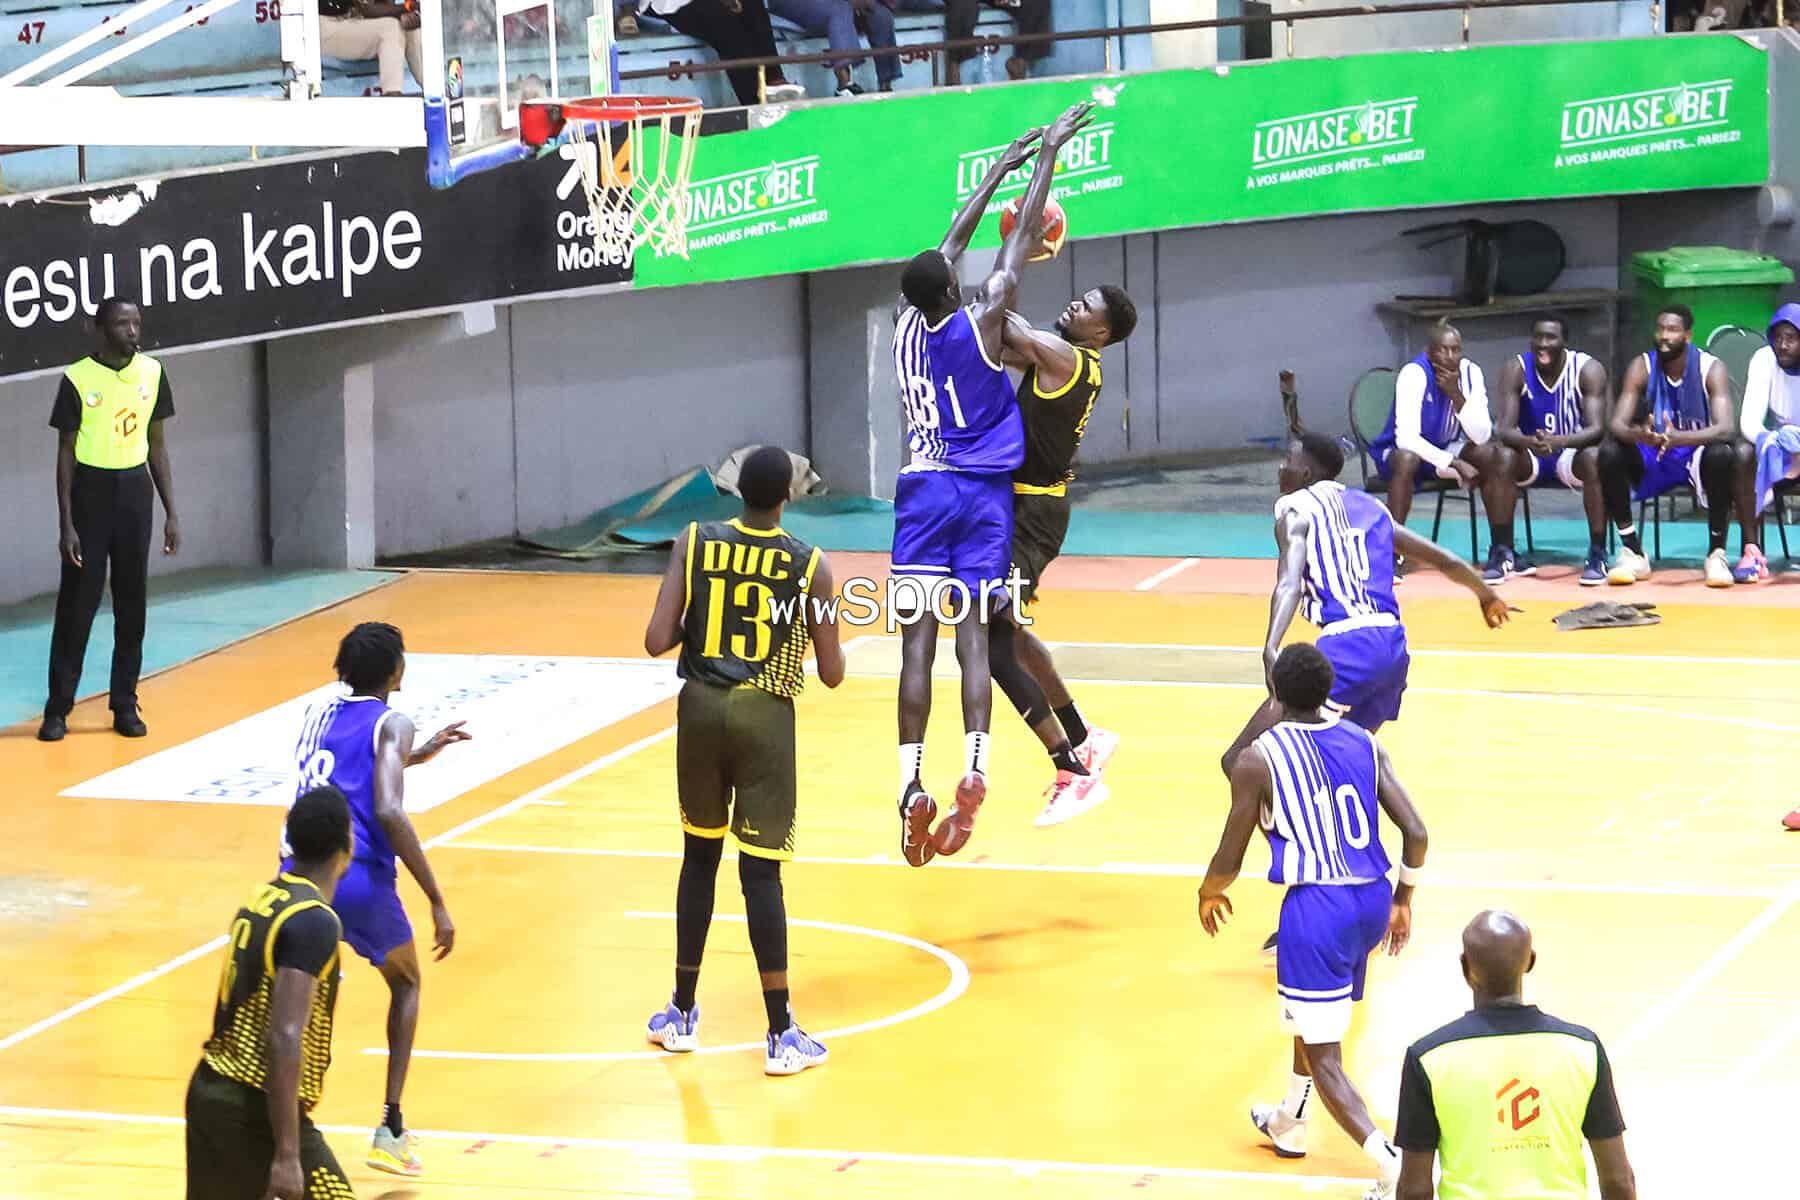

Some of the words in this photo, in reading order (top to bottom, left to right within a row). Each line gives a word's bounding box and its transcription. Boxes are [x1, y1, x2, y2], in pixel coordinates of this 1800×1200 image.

[17, 22, 46, 45] 47
[1565, 153, 1588, 166] VOS
[1590, 143, 1648, 162] MARQUES
[1256, 173, 1278, 187] VOS
[1280, 162, 1334, 182] MARQUES
[662, 176, 757, 228] ONASE
[689, 229, 743, 251] MARQUES
[0, 253, 115, 328] esu
[140, 238, 222, 306] na
[242, 201, 423, 298] kalpe
[556, 242, 633, 272] Money
[1544, 413, 1556, 433] 9
[703, 540, 792, 580] DUC
[702, 576, 775, 662] 13
[1313, 783, 1371, 850] 10
